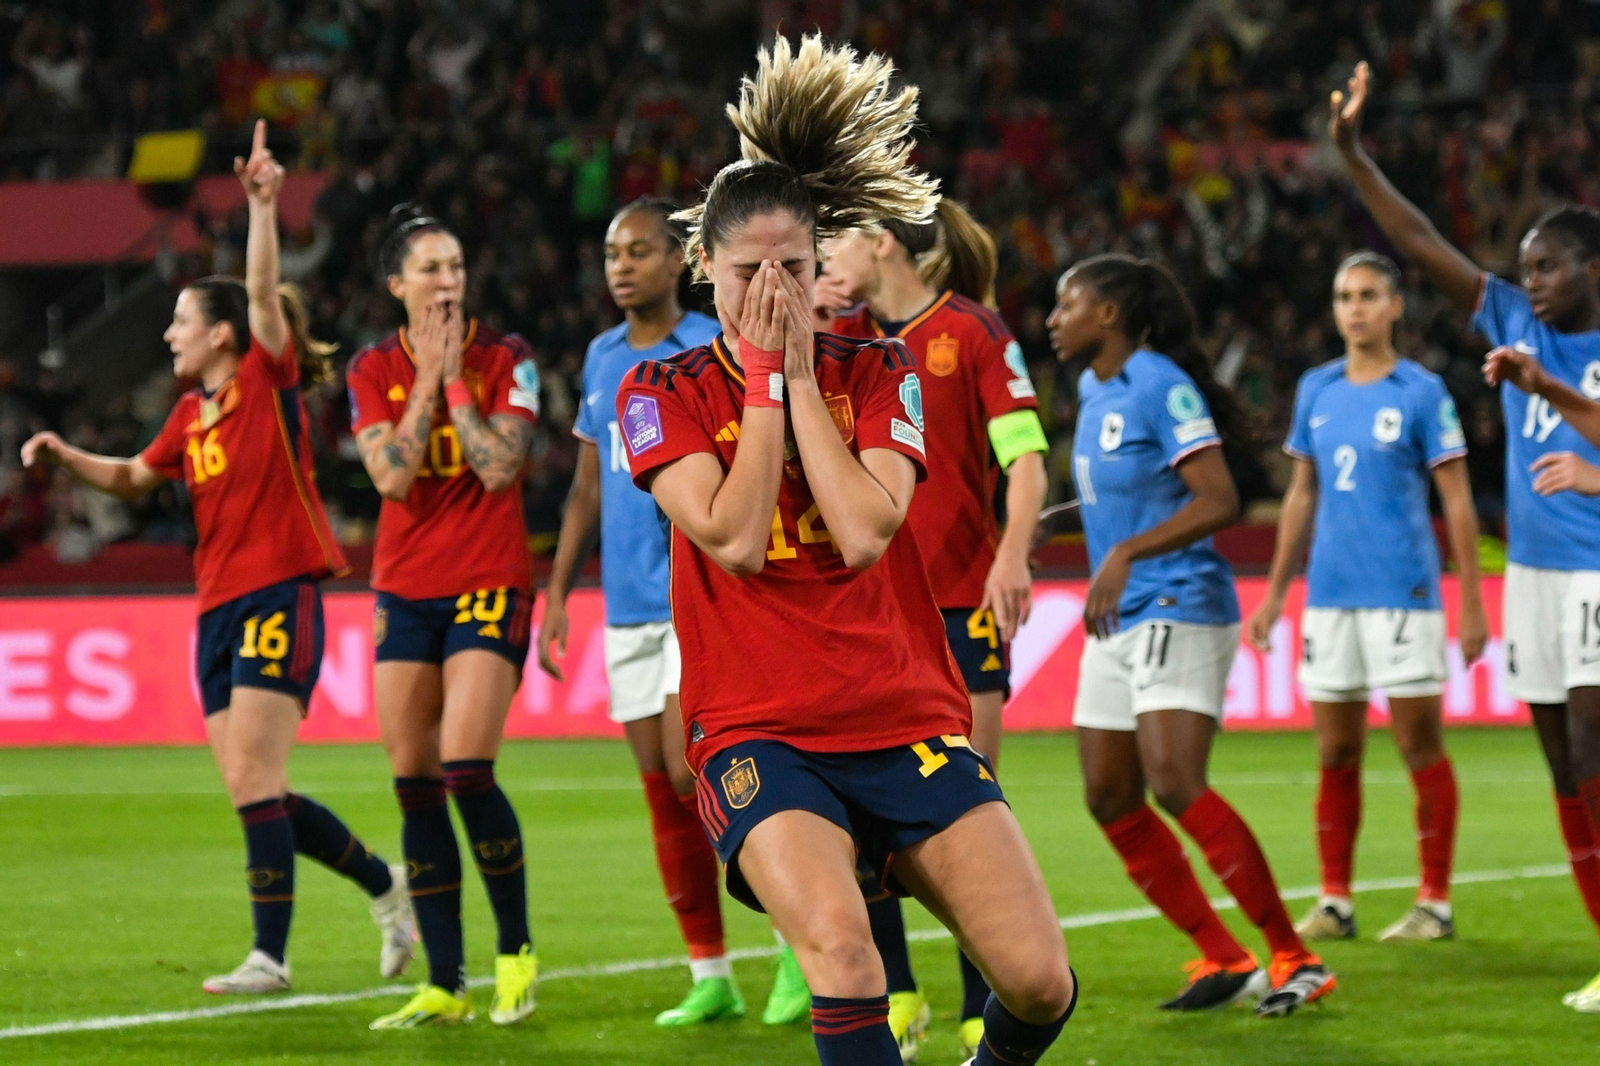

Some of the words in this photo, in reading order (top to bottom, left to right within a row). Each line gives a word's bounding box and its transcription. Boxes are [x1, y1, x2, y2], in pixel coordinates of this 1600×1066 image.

[187, 427, 228, 483] 16
[1334, 445, 1357, 491] 2
[239, 611, 289, 660] 16
[966, 607, 999, 649] 4
[1145, 624, 1172, 669] 11
